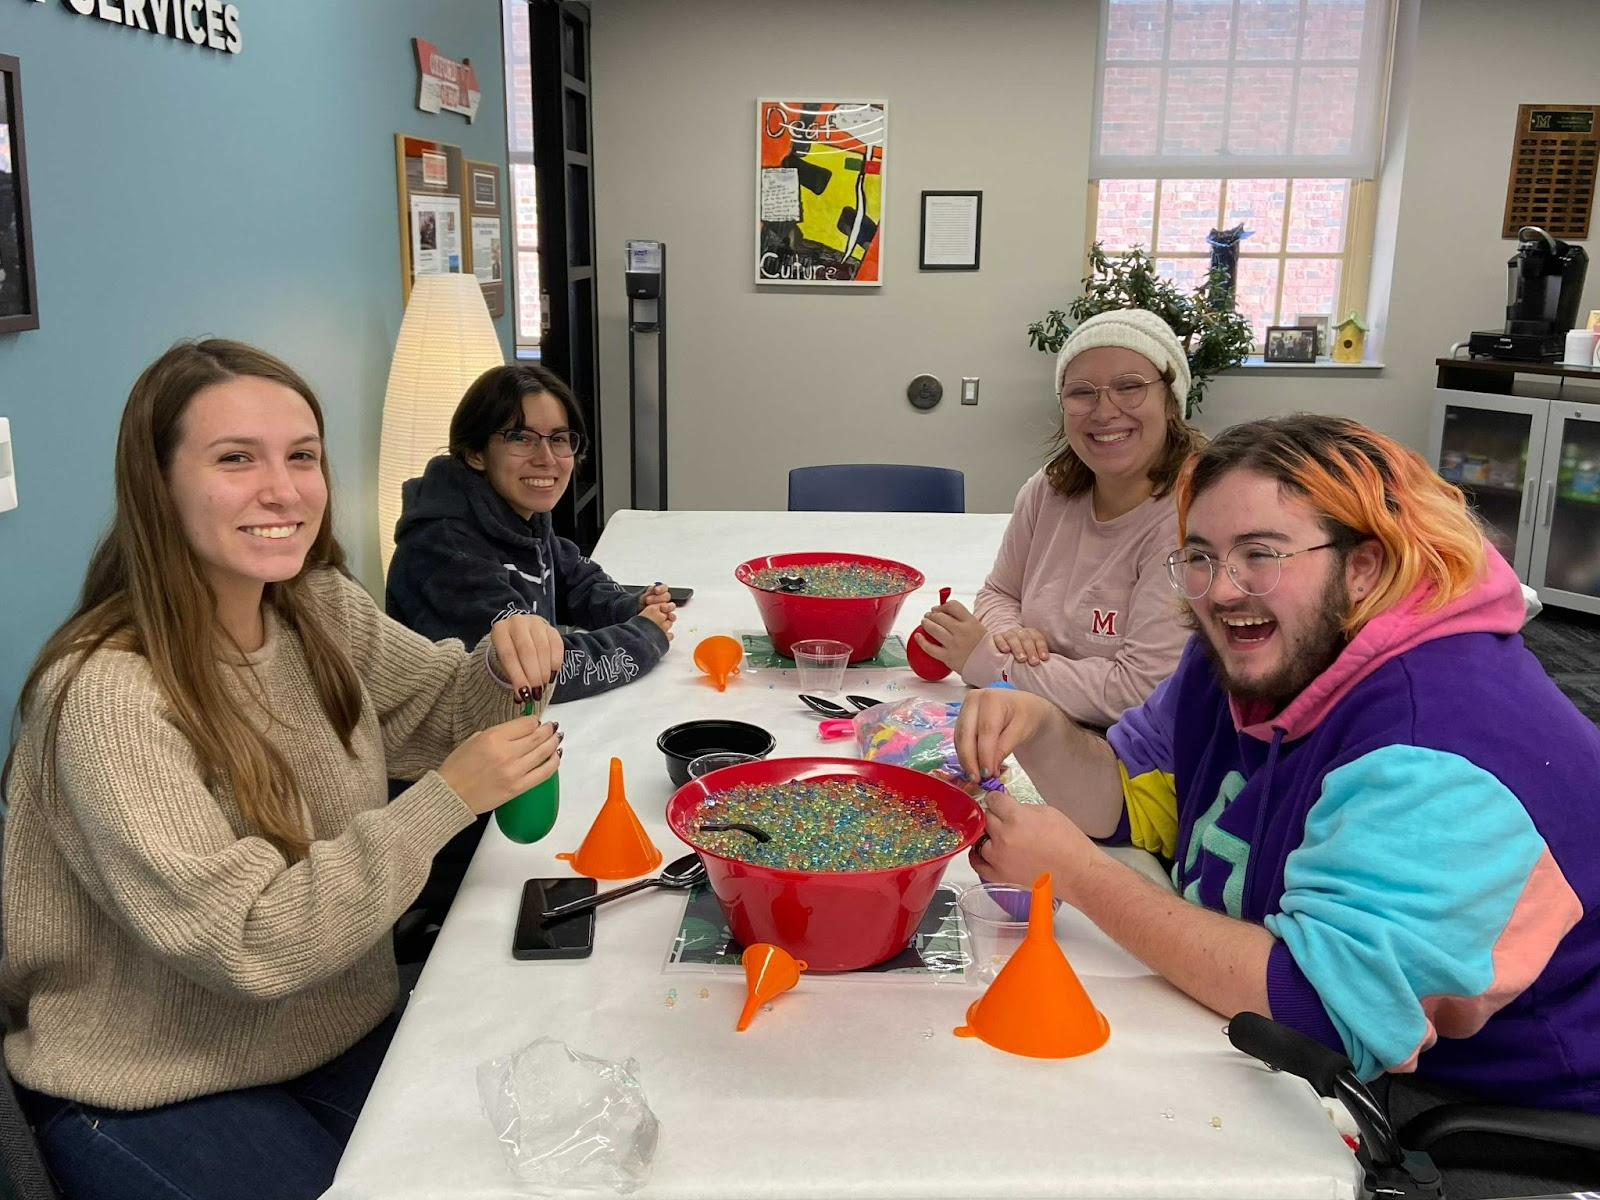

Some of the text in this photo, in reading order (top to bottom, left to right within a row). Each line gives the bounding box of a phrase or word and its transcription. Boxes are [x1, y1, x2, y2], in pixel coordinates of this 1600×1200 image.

[766, 107, 836, 140] Deaf
[760, 252, 837, 280] Culture
[1091, 609, 1118, 636] M
